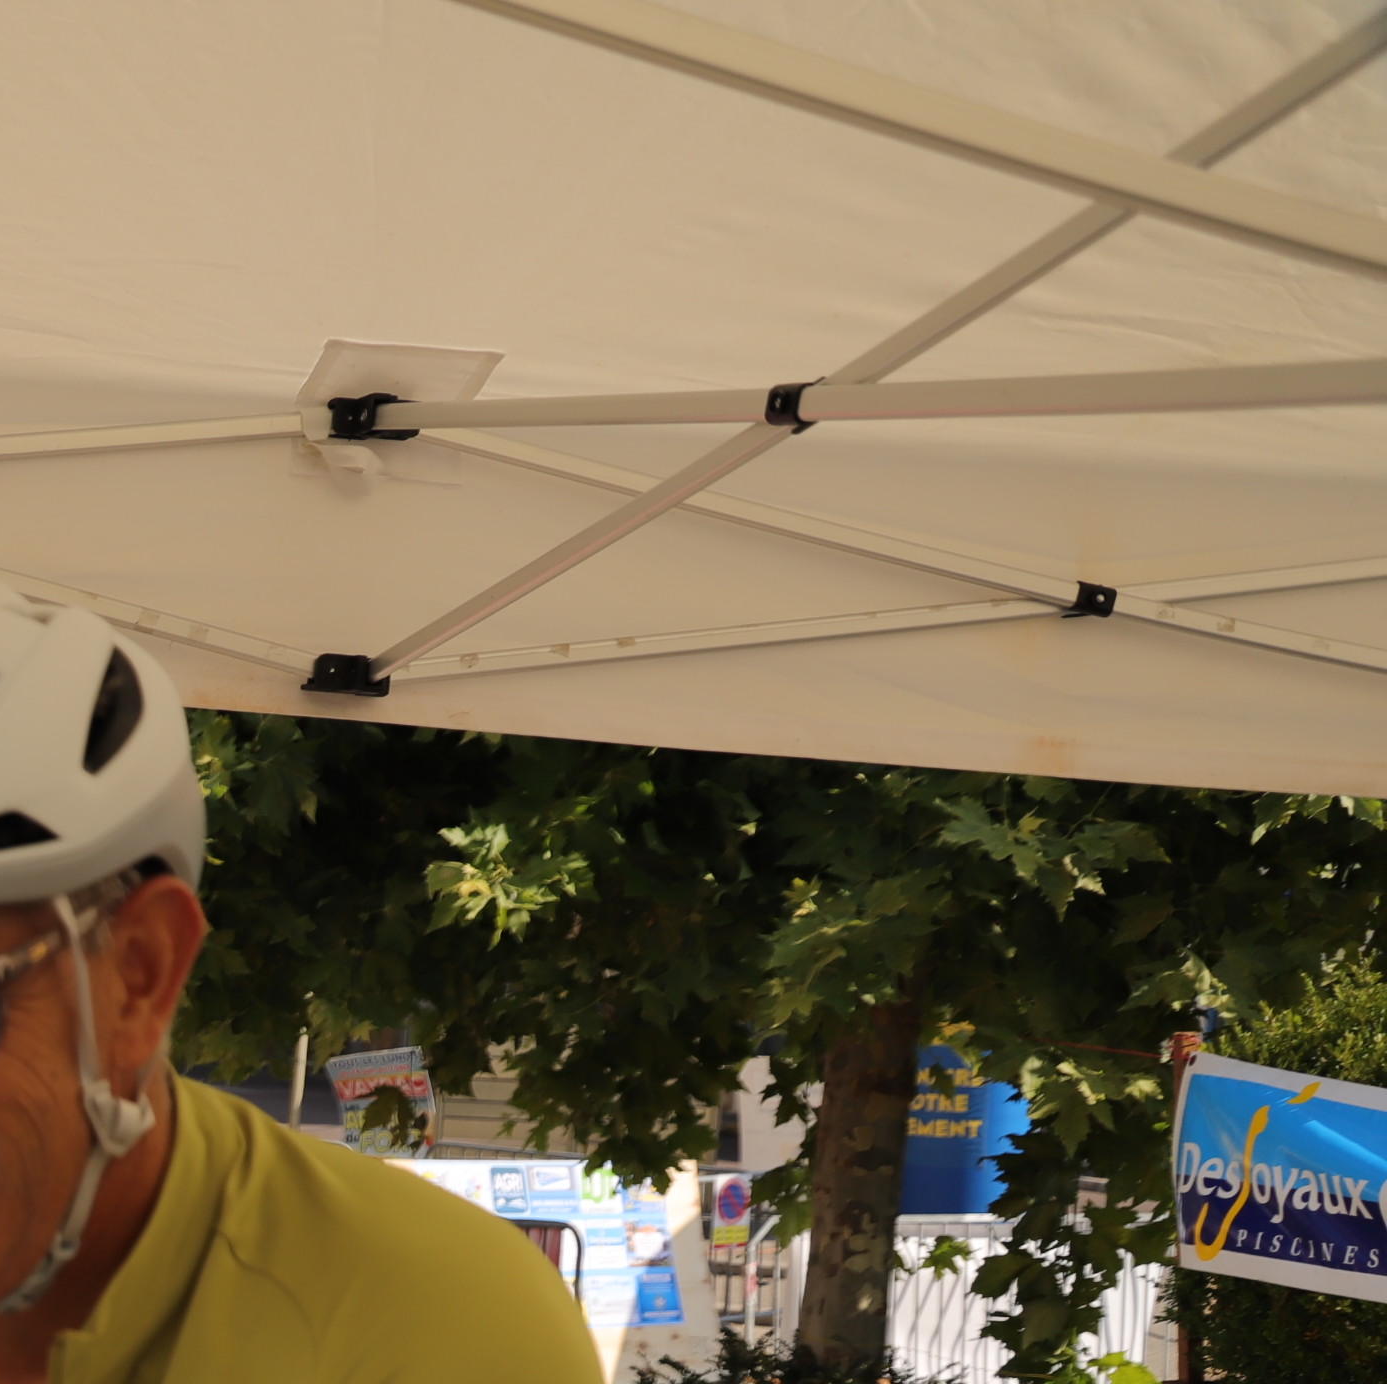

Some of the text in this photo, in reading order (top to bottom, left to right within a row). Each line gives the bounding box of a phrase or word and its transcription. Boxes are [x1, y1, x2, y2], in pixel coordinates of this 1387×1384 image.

[909, 1093, 969, 1113] OTRE
[906, 1117, 983, 1138] EMENT
[1235, 1228, 1380, 1268] PISCINES
